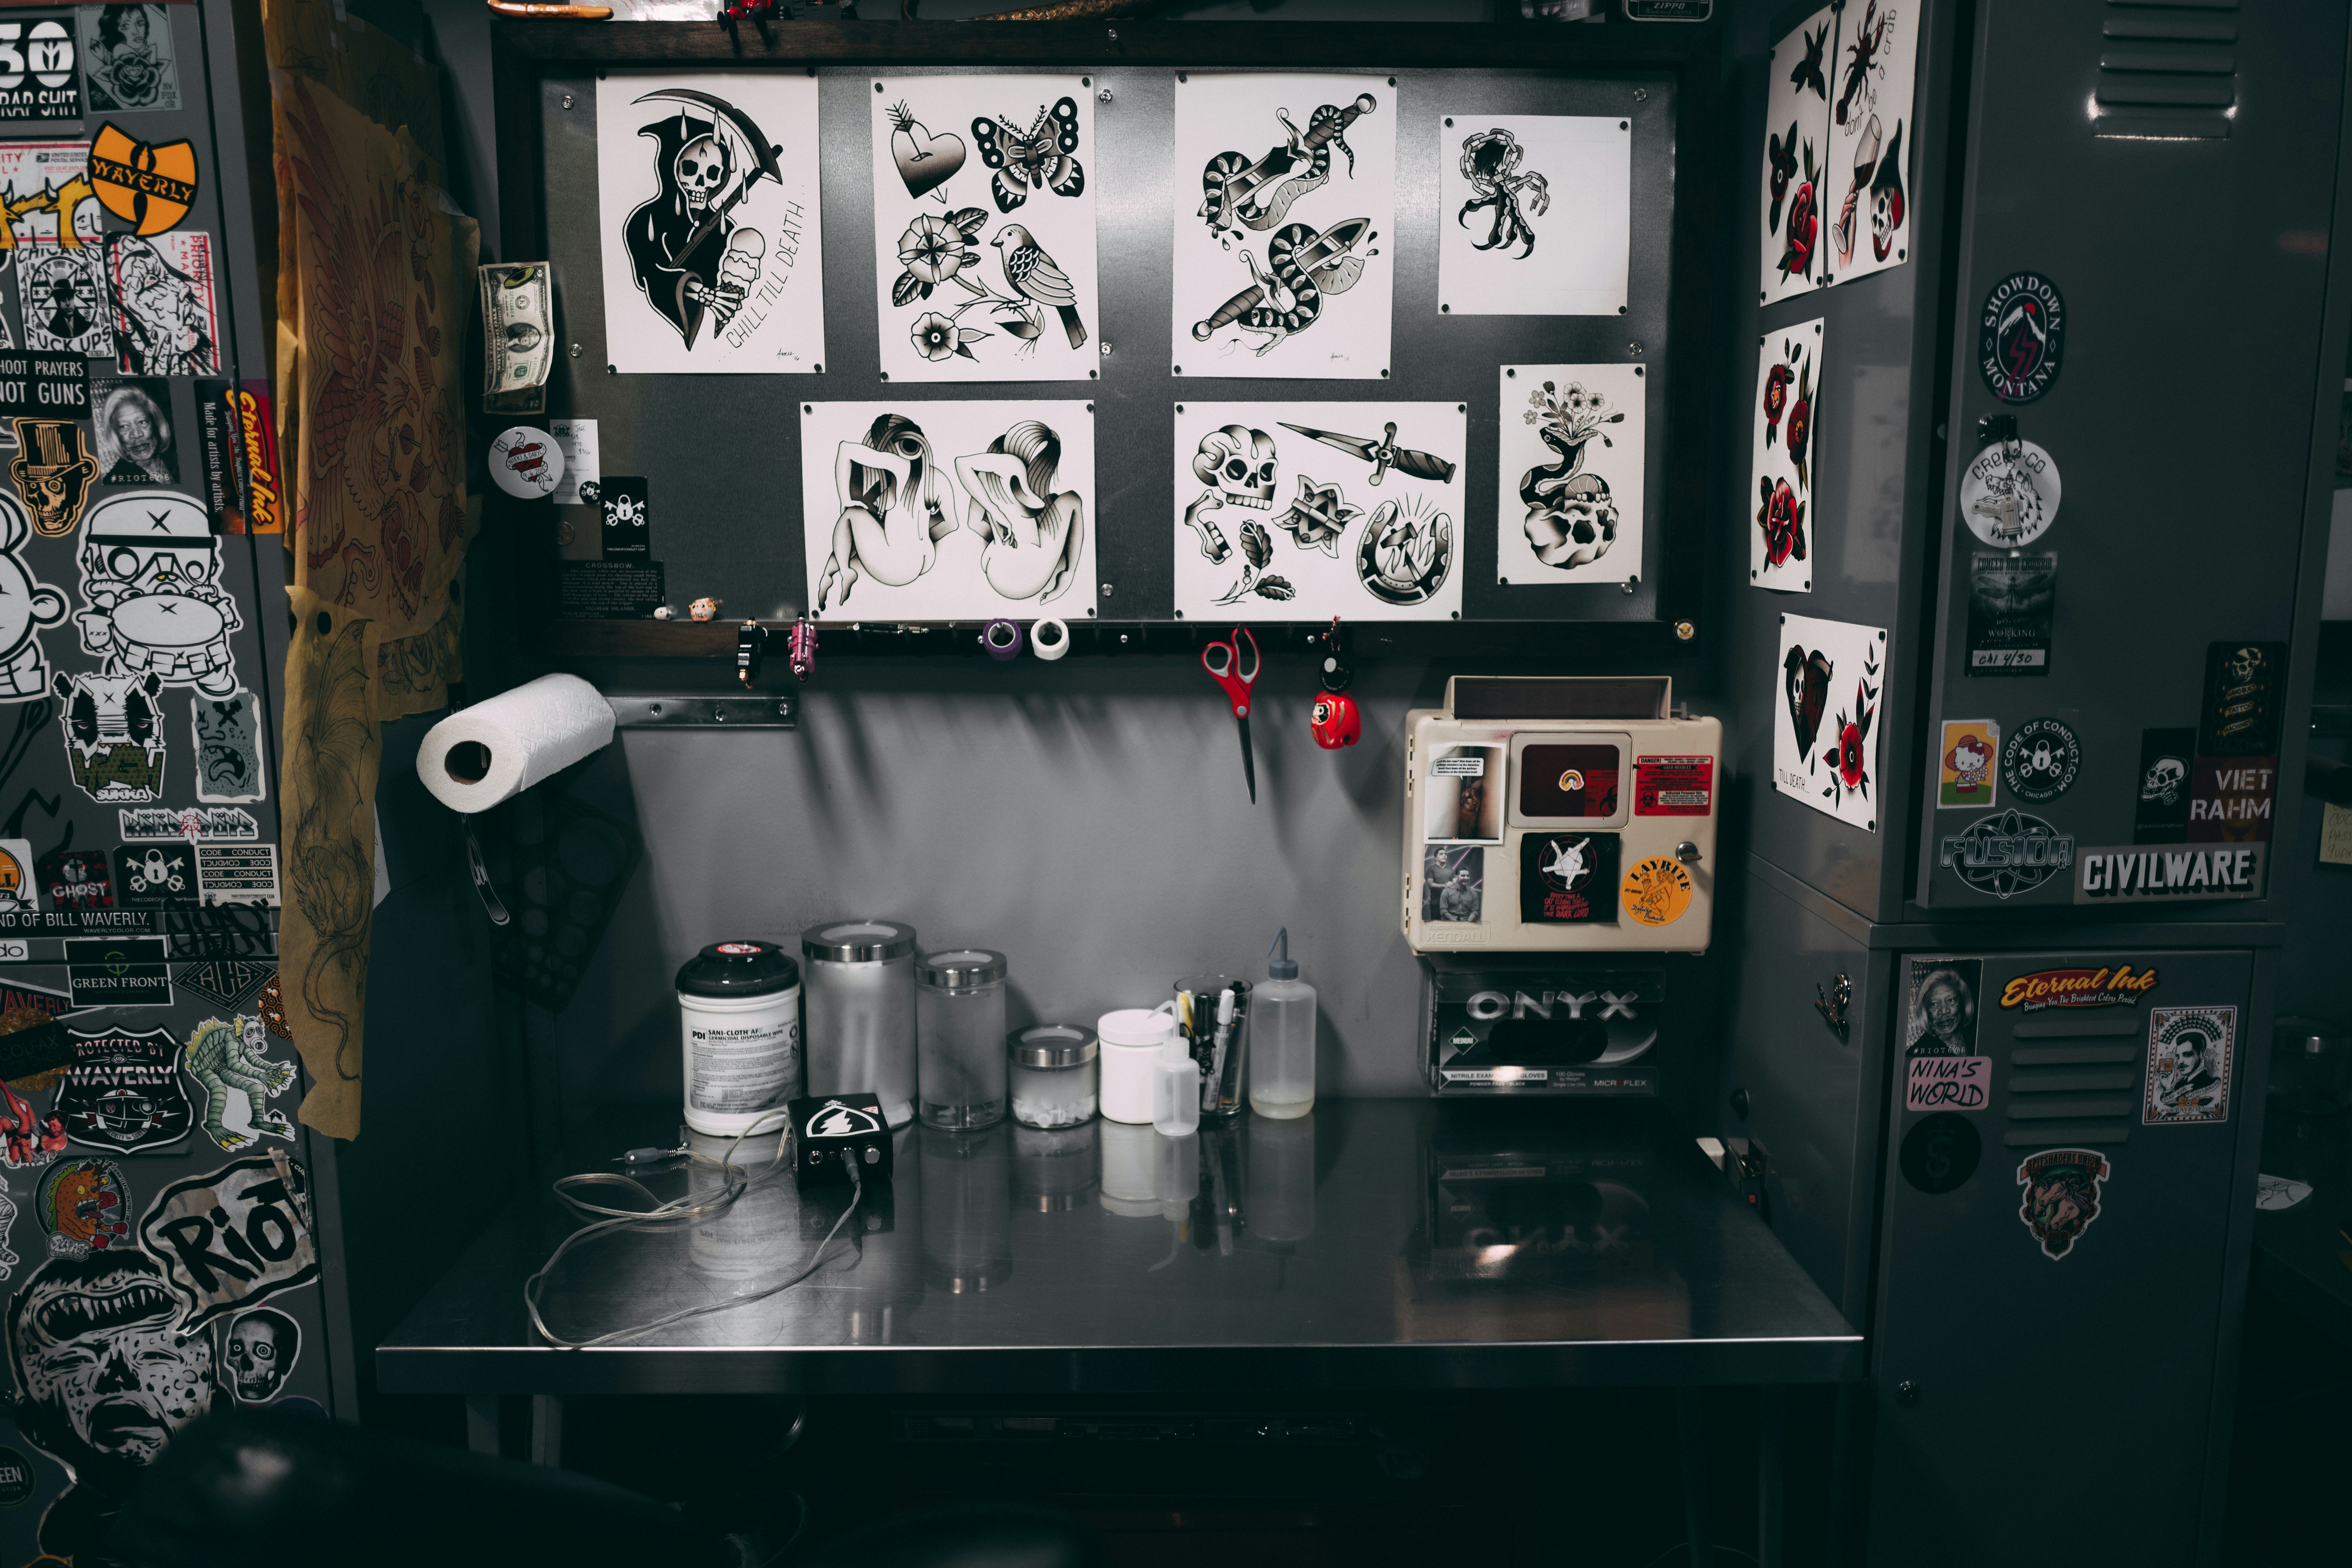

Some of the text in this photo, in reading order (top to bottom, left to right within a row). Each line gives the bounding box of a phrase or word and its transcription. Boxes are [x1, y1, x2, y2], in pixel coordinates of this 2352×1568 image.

[1884, 9, 1896, 54] crab
[38, 91, 77, 116] SHIT
[1868, 88, 1877, 113] be
[1845, 105, 1864, 136] don't
[92, 158, 194, 201] WAVERLY
[17, 249, 101, 263] CHICAGO
[756, 272, 788, 306] TILL
[1985, 276, 2061, 332] SHOWDOWN
[726, 307, 767, 348] CHILL
[26, 325, 111, 352] FUCK UPS
[35, 361, 83, 377] PRAYERS
[1984, 356, 2056, 396] MONTANA
[38, 381, 85, 405] GUNS
[203, 402, 224, 513] Made for artists by artists.
[225, 389, 275, 524] Eternal Ink
[508, 455, 522, 465] NIKKI
[111, 473, 170, 483] #RIOT666
[1978, 557, 2052, 571] COHEED AND CAMBRIA
[1988, 629, 2035, 637] WORKING
[1978, 653, 1998, 665] chi
[2227, 702, 2254, 715] TATTOO
[2223, 718, 2254, 735] MACHINES
[2004, 720, 2078, 793] THE CODE OF CONDUCT.COM
[1779, 768, 1788, 784] TILL
[2215, 769, 2273, 791] VIET
[97, 788, 148, 800] SUKKA
[2025, 790, 2053, 799] CHICAGO
[2190, 799, 2270, 820] RAHM
[1940, 836, 2074, 869] FUSION
[1630, 859, 1690, 892] LAYRITE
[2083, 849, 2256, 896] CIVILWARE
[52, 882, 107, 898] GHOST
[1555, 909, 1573, 918] DARK
[1573, 907, 1590, 918] LORD
[1556, 901, 1589, 910] WORSHIPPING
[22, 912, 150, 926] OF BILL WAVERLY.
[1644, 913, 1665, 922] Pomade
[1426, 932, 1485, 943] KENDALL
[73, 976, 167, 988] GREEN FRONT
[254, 978, 266, 989] STEEL
[2001, 965, 2158, 1007] Eternal Ink
[0, 988, 69, 1015] AVERLY
[184, 984, 197, 992] LOYAL
[213, 996, 227, 1005] TRADE
[2024, 992, 2116, 1012] Bringing You The Brightest Colors
[1466, 990, 1639, 1022] ONYX
[693, 1031, 705, 1040] PDI
[72, 1039, 163, 1058] ROTECTED BY
[67, 1065, 173, 1087] WAVERLY
[1911, 1059, 1982, 1078] NINA'S
[1911, 1081, 1984, 1107] WORLD
[2163, 1089, 2201, 1102] STAY WITH
[2027, 1153, 2101, 1170] SPITSHADERS UNION
